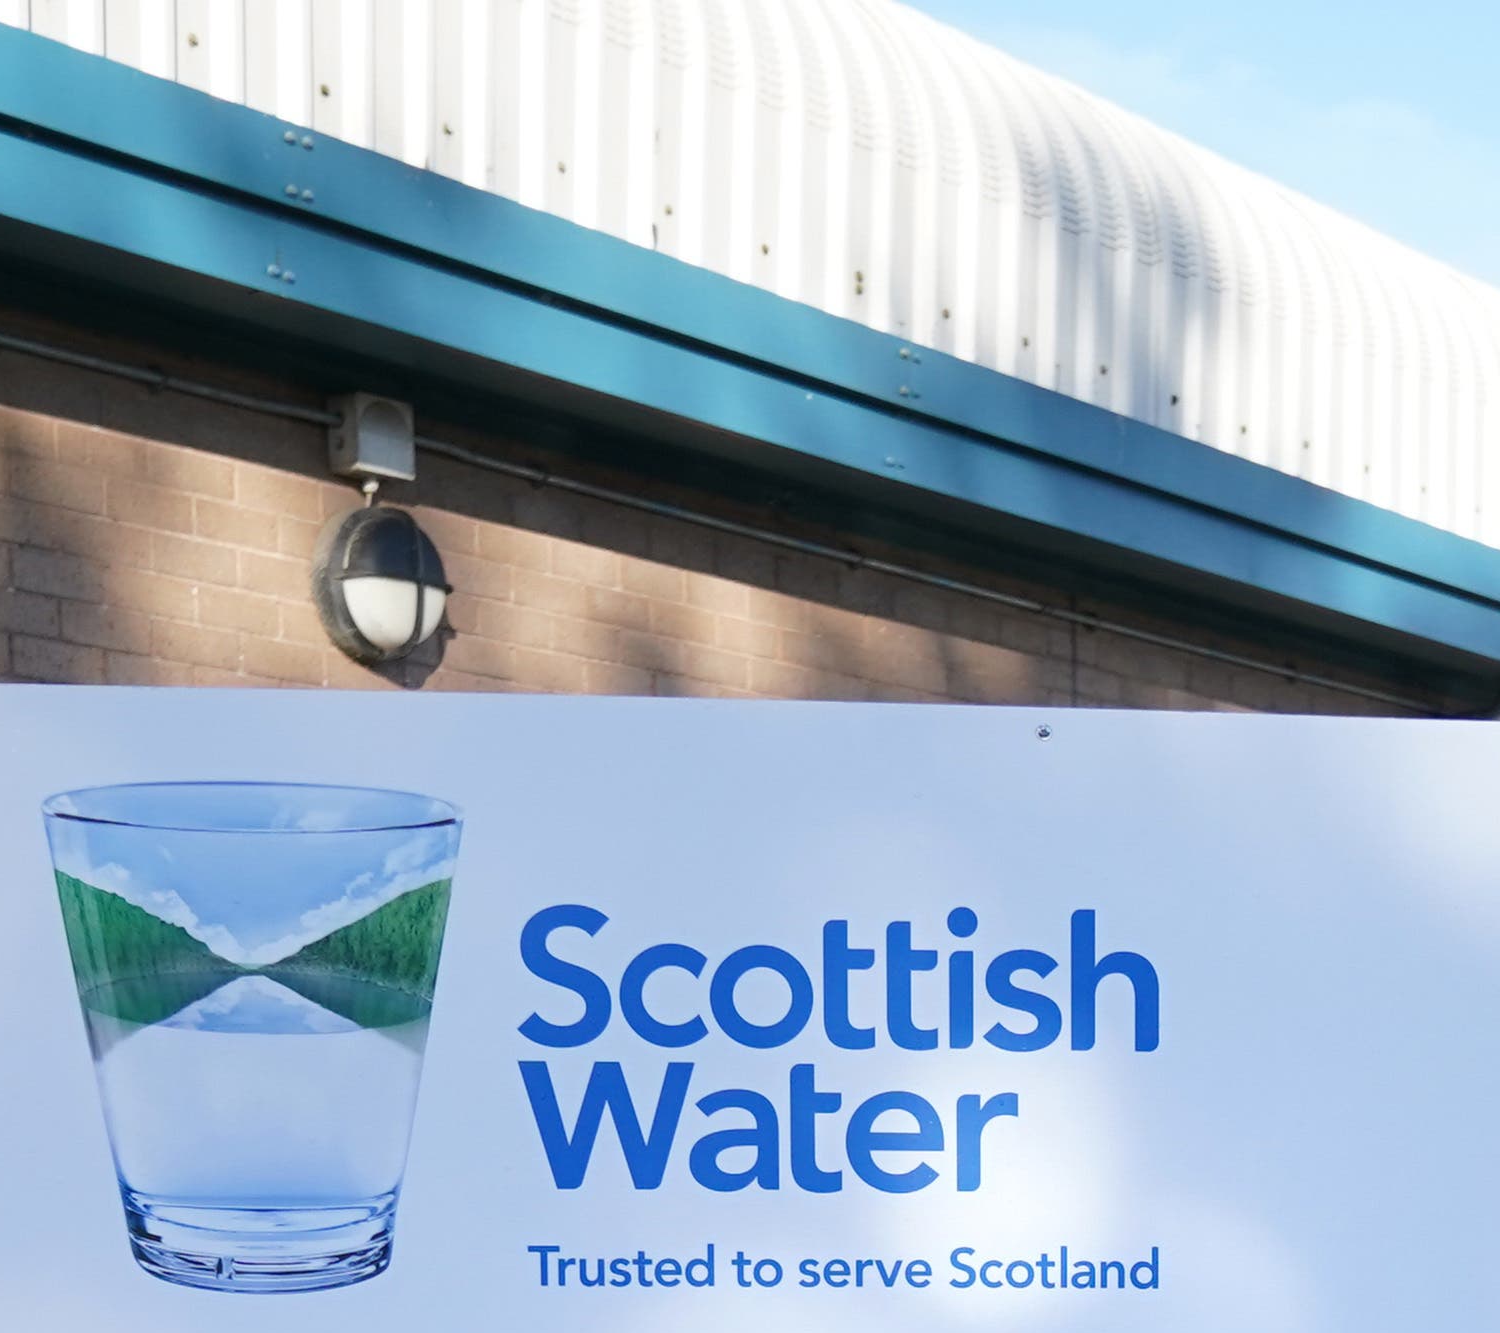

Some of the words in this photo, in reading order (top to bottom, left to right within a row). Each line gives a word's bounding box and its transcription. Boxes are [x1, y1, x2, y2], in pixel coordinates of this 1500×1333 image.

[516, 903, 1159, 1052] Scottish
[516, 1061, 1018, 1193] Water
[528, 1243, 716, 1290] Trusted
[732, 1252, 784, 1290] to
[798, 1259, 932, 1291] serve
[948, 1248, 1159, 1292] Scotland
